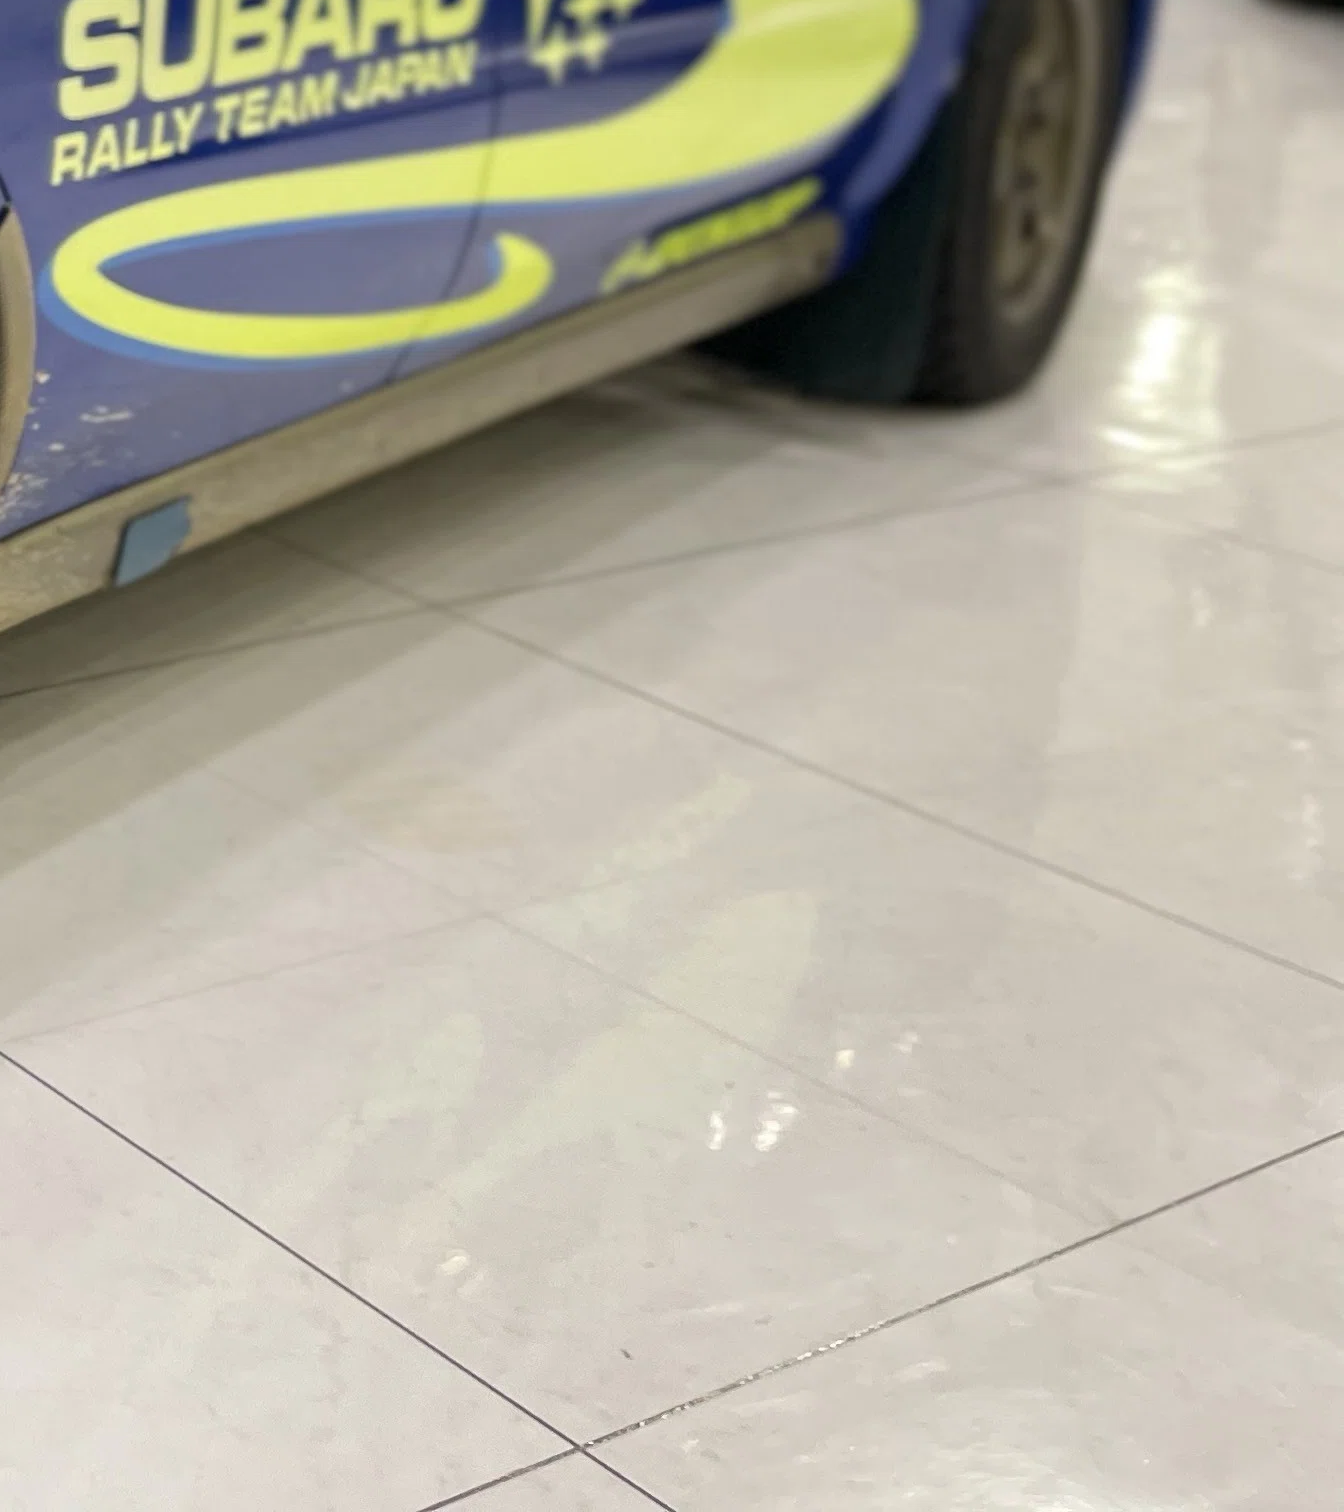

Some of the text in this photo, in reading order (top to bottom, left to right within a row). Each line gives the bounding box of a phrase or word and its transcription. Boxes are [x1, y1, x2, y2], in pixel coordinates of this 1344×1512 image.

[50, 41, 479, 186] RALLY TEAM JAPAN
